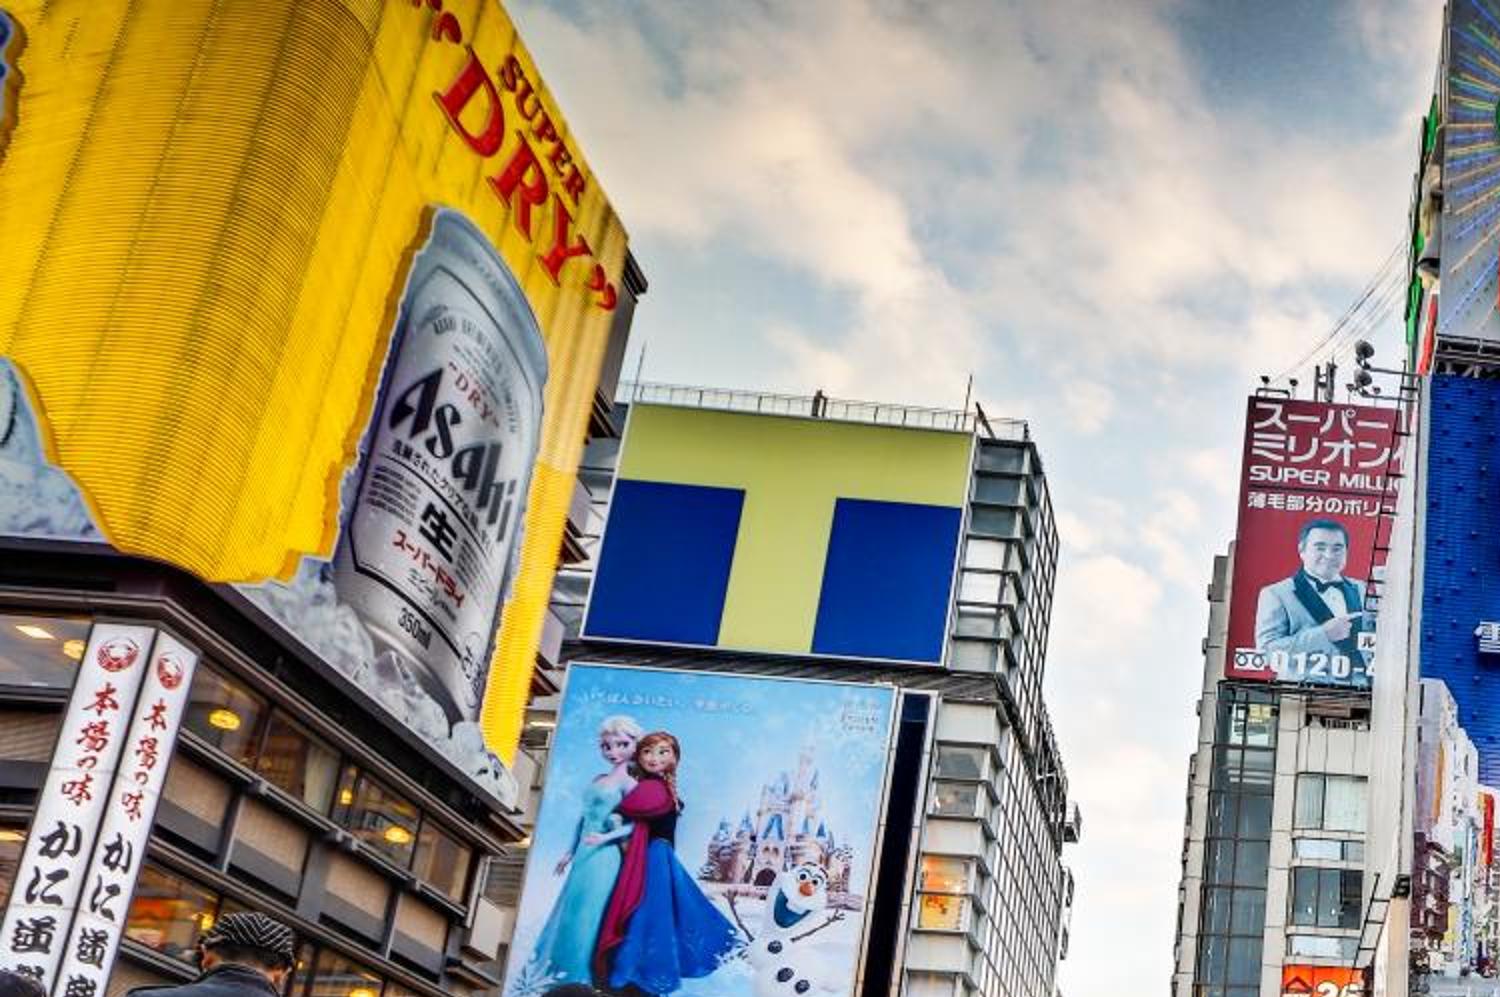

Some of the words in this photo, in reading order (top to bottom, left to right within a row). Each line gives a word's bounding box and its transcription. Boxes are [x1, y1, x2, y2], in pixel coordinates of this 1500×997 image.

[500, 54, 585, 206] SUPER
[389, 368, 517, 543] Asahi
[1253, 402, 1388, 436] スーパー
[1250, 465, 1330, 485] SUPER
[393, 530, 464, 608] スーパードライ
[419, 502, 457, 564] 生
[398, 607, 432, 650] 350ml
[61, 682, 120, 806] 本場の味
[121, 698, 170, 822] 本場の味
